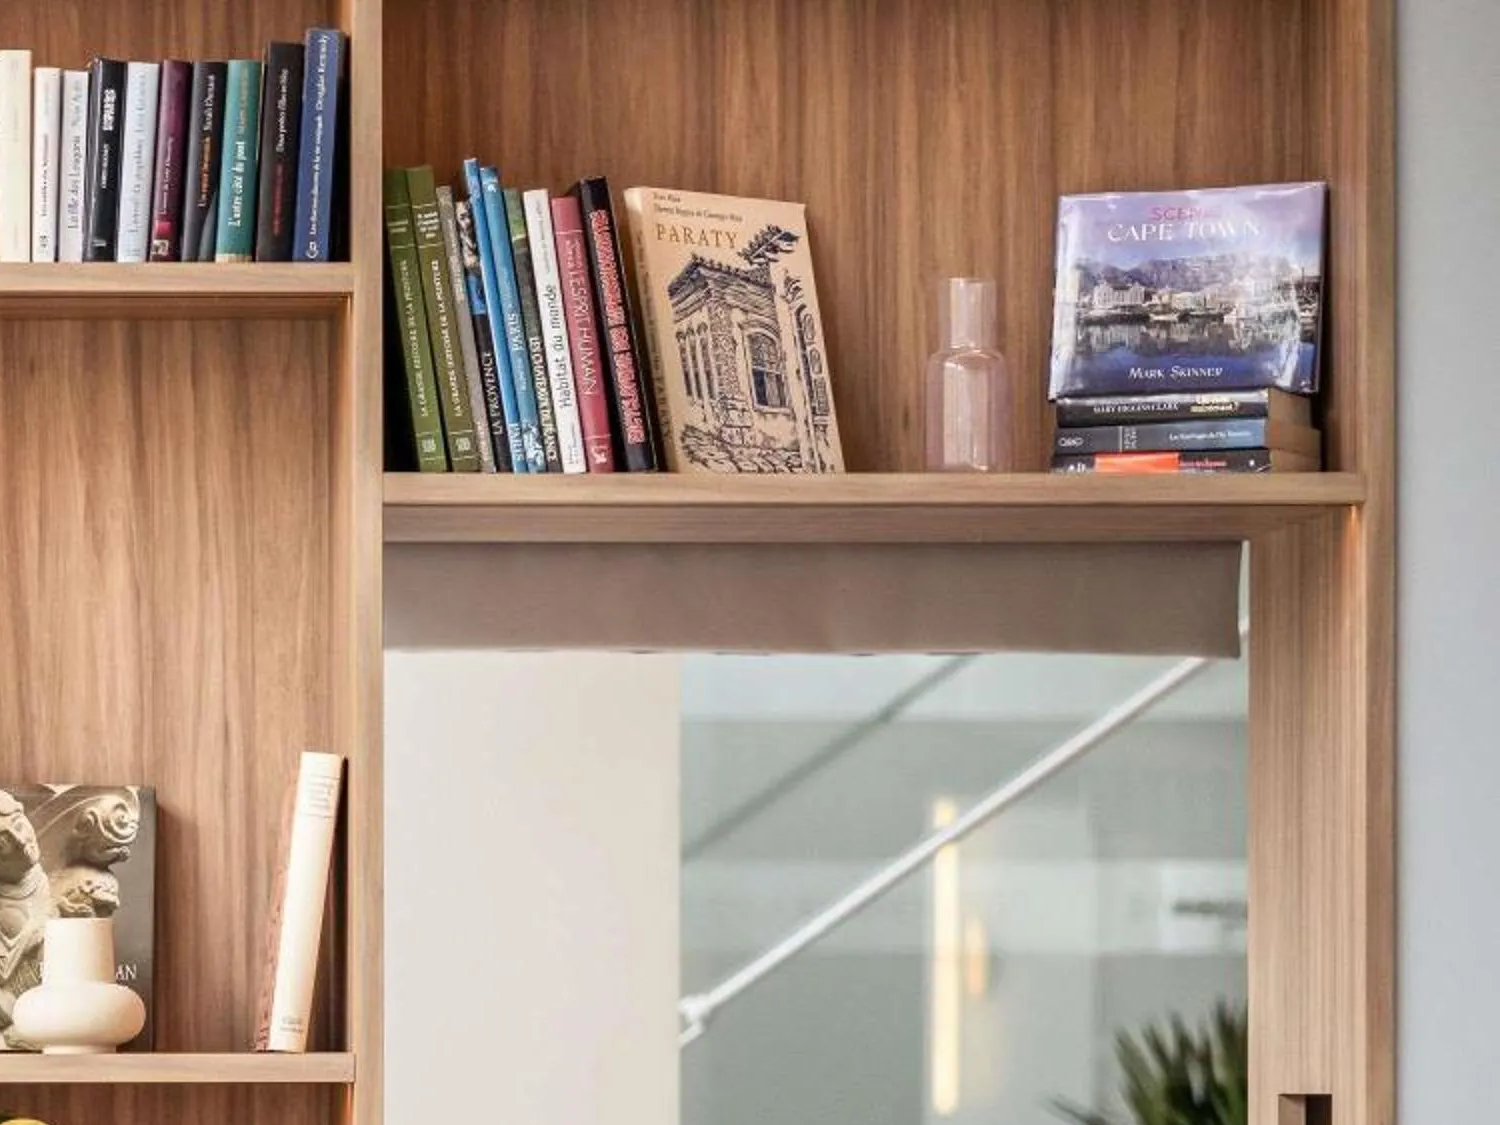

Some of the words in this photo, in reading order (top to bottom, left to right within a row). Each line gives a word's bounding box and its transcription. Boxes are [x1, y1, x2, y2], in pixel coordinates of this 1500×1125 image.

[315, 34, 330, 72] Kennedy
[314, 75, 327, 110] Douglas
[227, 195, 242, 226] L'autre
[657, 223, 737, 249] PARATY
[1107, 220, 1173, 244] CAPE
[1188, 215, 1259, 239] TOWN
[541, 284, 561, 330] monde
[506, 312, 524, 351] PARIS
[551, 334, 564, 351] du
[573, 325, 601, 395] HUMAIN
[1128, 366, 1165, 379] MARK
[480, 350, 501, 417] PROVENCE
[551, 356, 572, 408] Habitat
[491, 420, 503, 435] LA
